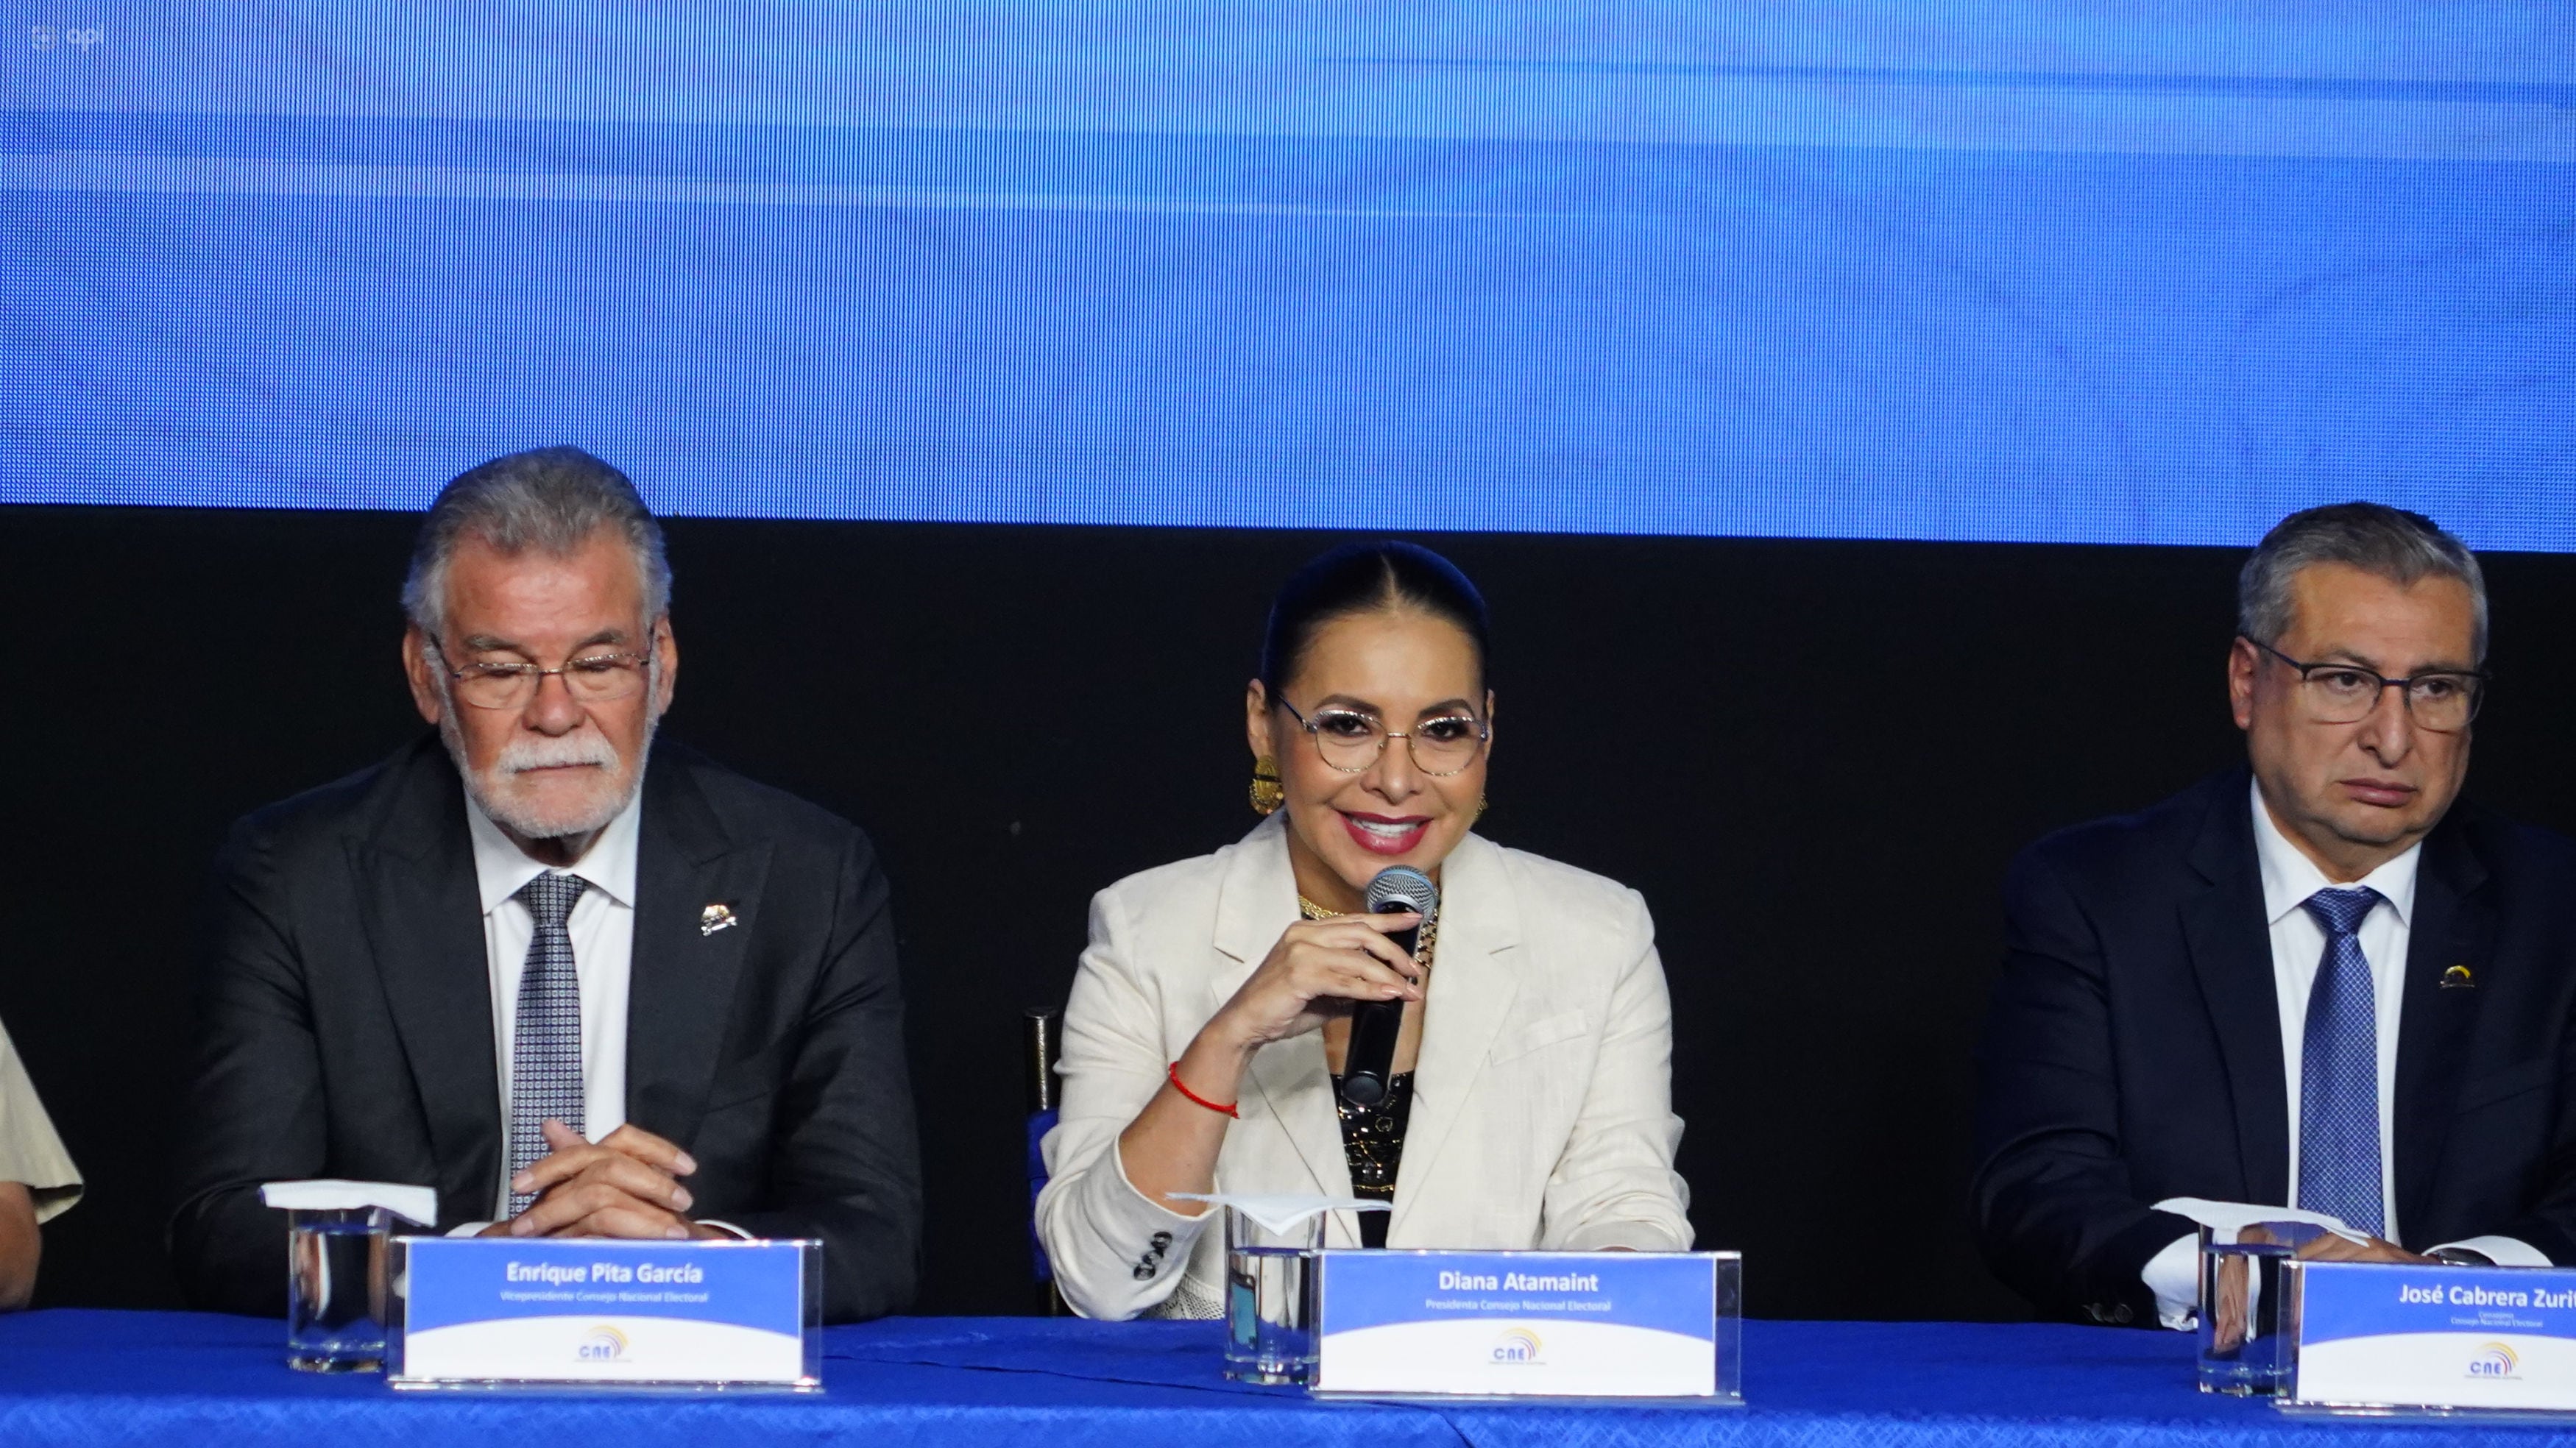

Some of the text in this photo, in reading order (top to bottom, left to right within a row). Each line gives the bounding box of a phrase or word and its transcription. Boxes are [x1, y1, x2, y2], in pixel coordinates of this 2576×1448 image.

[506, 1261, 704, 1286] Enrique Pita García
[1439, 1271, 1599, 1292] Diana Atamaint
[500, 1291, 709, 1304] Vicepresidente Consejo Nacional Electoral
[1426, 1299, 1611, 1312] Presidenta Consejo Nacional Electoral
[2399, 1284, 2444, 1304] José
[2449, 1286, 2528, 1307] Cabrera
